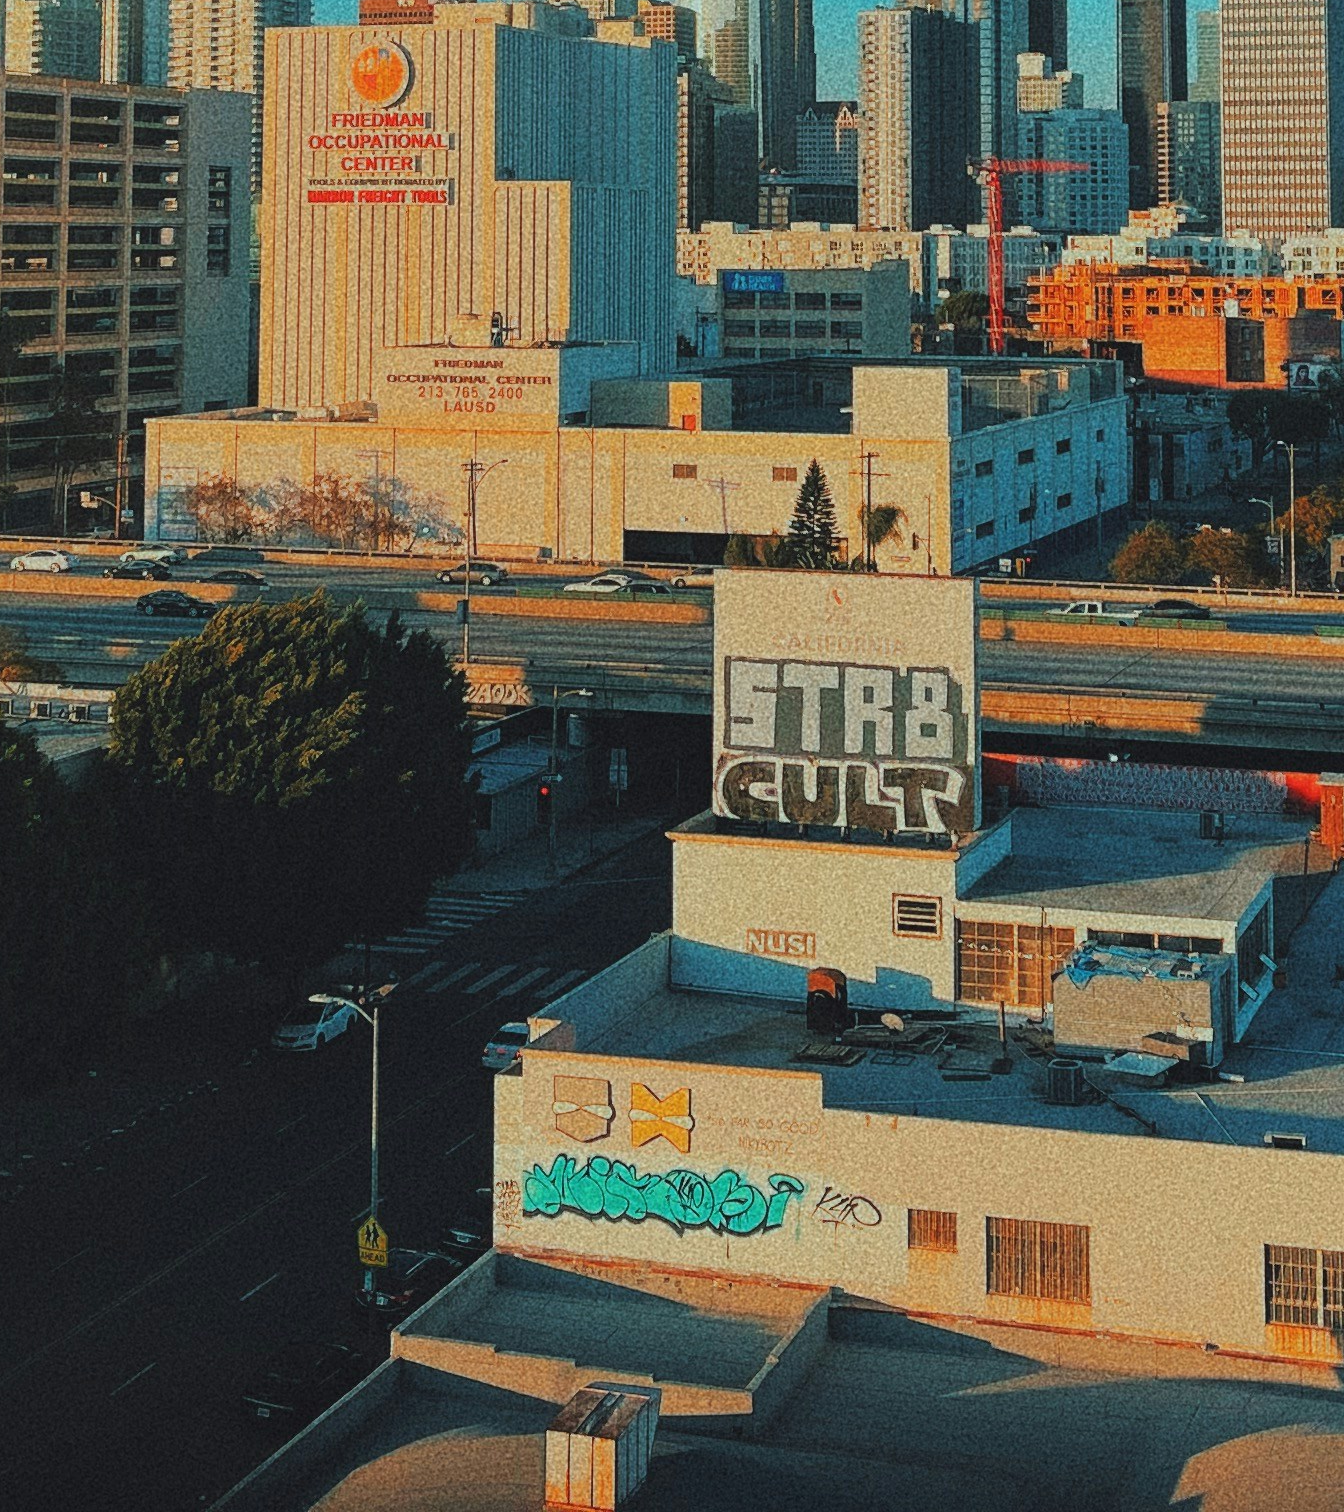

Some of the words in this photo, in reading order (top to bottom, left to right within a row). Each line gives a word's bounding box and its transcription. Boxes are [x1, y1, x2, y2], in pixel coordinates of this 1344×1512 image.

[331, 112, 424, 128] FRIEDMAN
[308, 133, 448, 149] OCCUPATIONAL
[340, 156, 413, 171] CENTER
[308, 178, 336, 186] TOOLS
[357, 190, 407, 203] FREIGHT
[410, 190, 447, 203] TOOLS
[434, 359, 504, 369] FRIEDMAN
[387, 374, 490, 385] OCCUPATIONAL
[496, 375, 552, 385] CENTER
[418, 385, 444, 398] 213
[454, 386, 479, 399] 765
[489, 386, 523, 399] 2400
[444, 400, 496, 413] LAUSD
[771, 631, 906, 656] CALIFORNIA
[747, 930, 815, 957] NUSI
[359, 1249, 386, 1263] AHEAD
